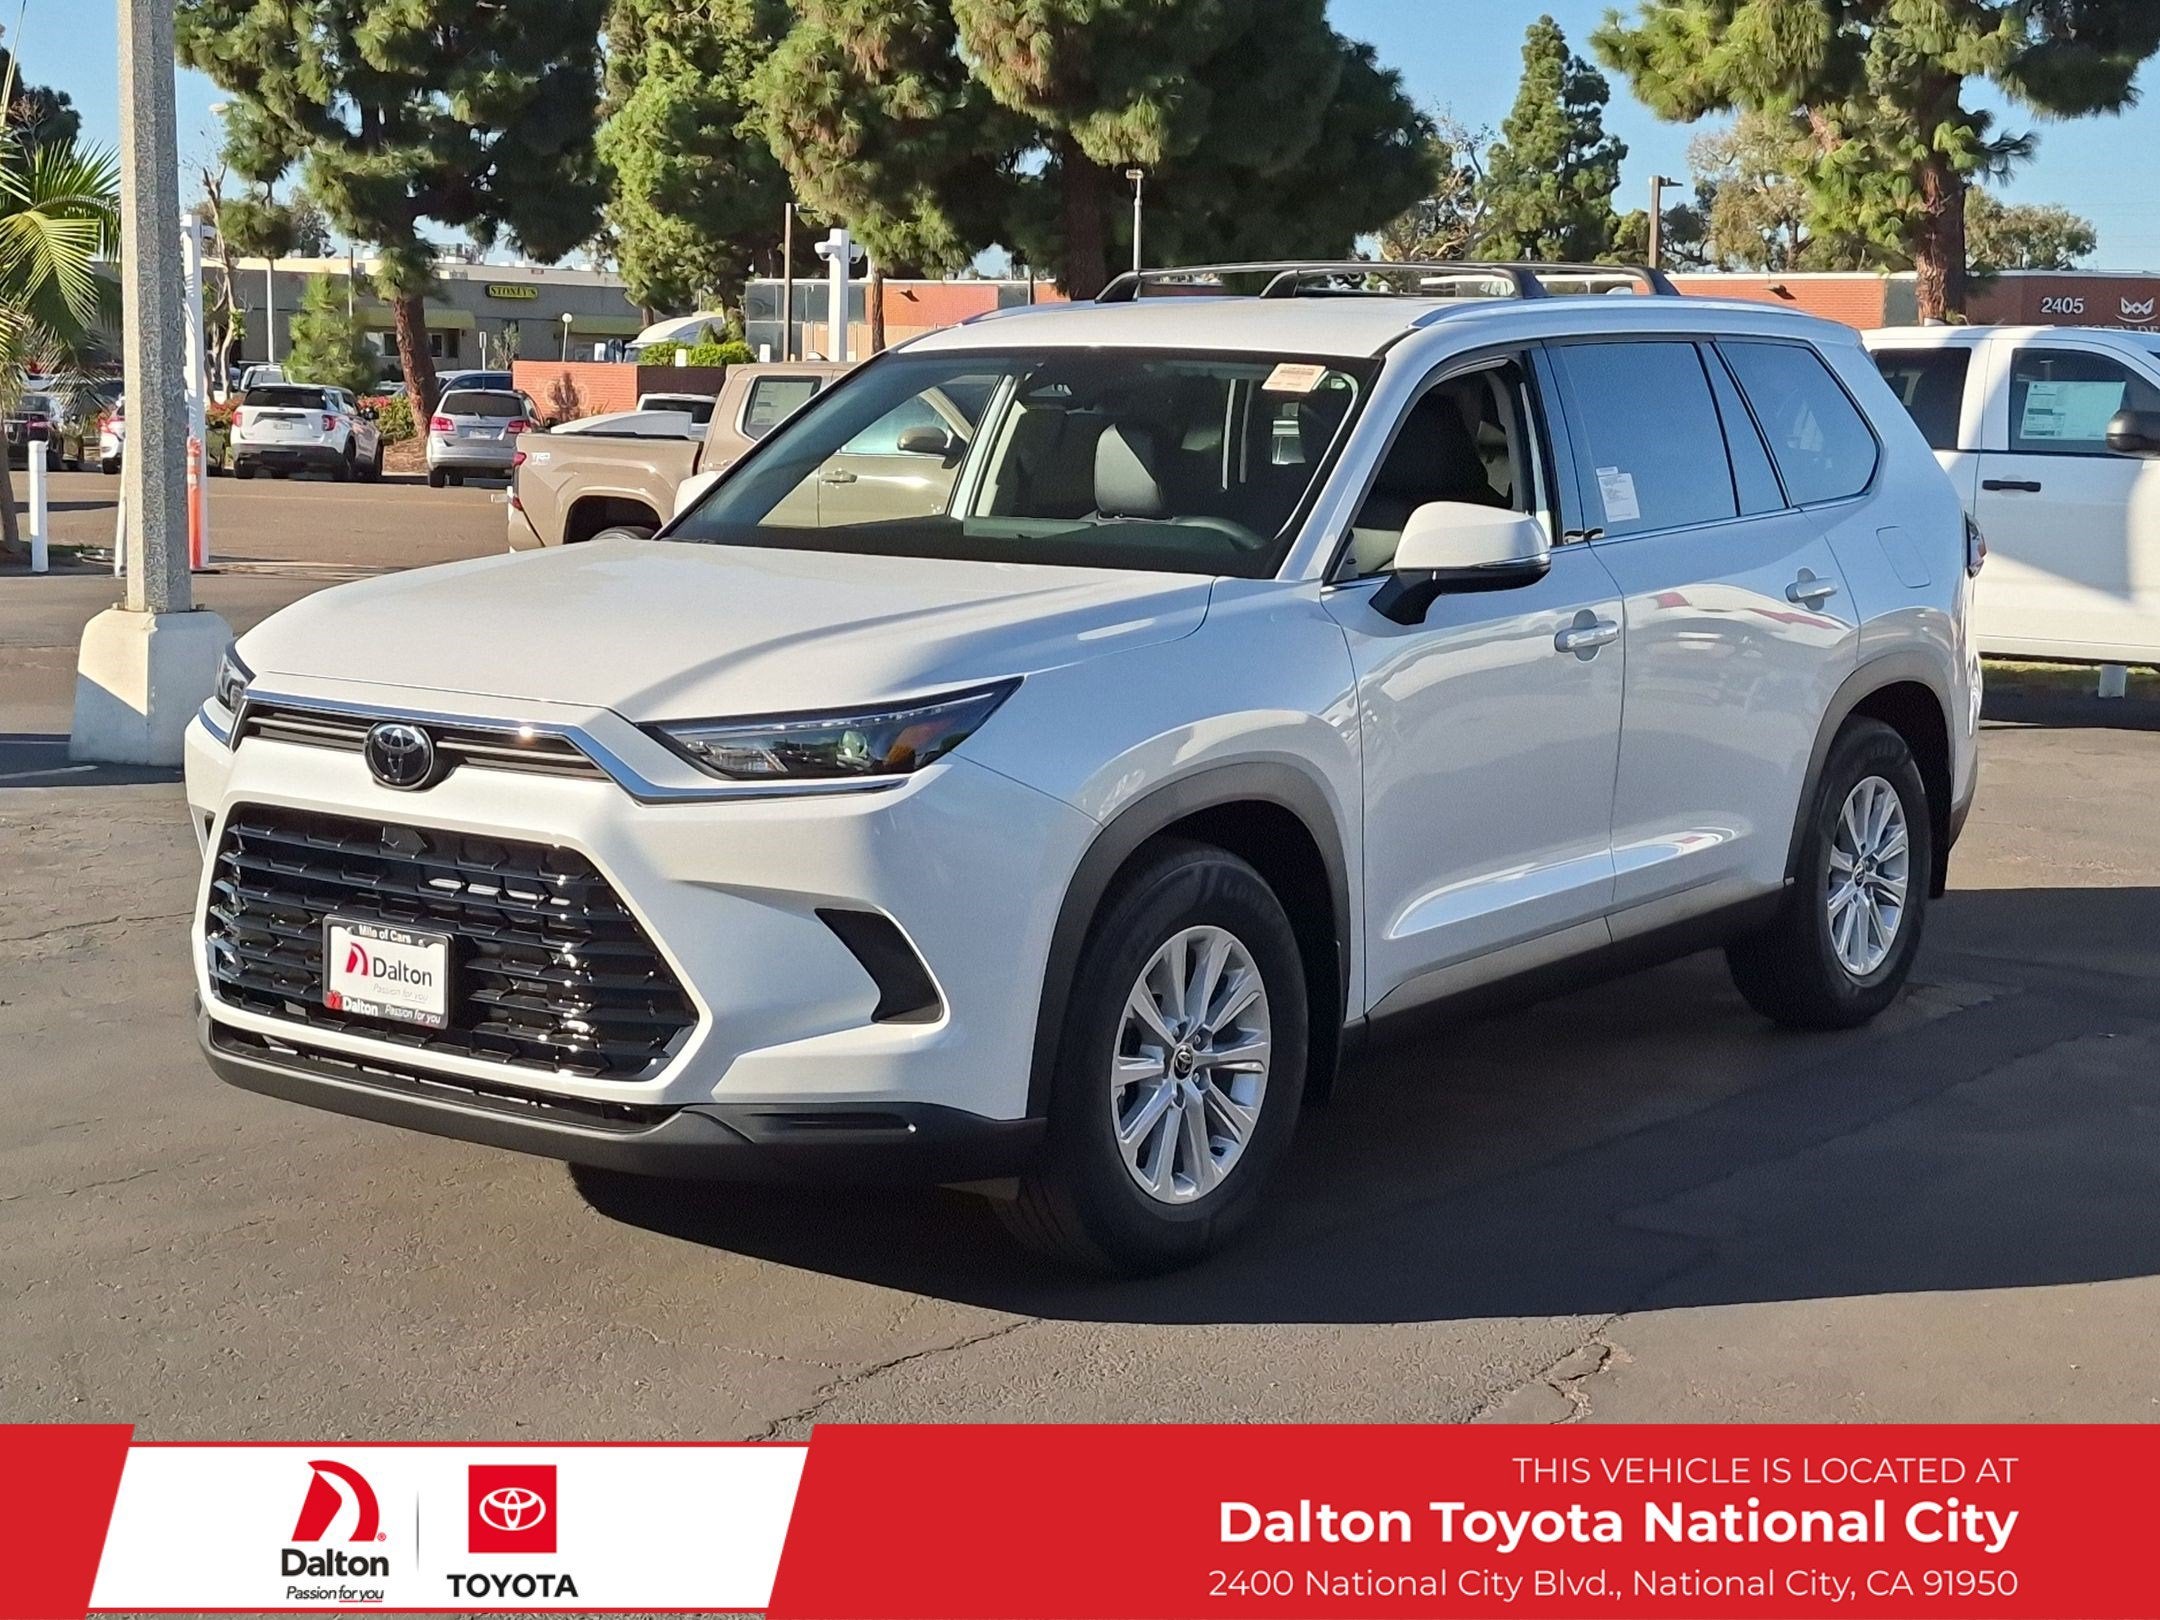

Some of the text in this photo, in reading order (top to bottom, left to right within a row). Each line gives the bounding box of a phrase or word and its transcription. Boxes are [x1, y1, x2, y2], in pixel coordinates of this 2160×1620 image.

[2041, 297, 2084, 314] 2405
[359, 925, 411, 943] Mile of Cars
[373, 956, 432, 987] Dalton
[343, 996, 379, 1017] Dalton
[385, 1004, 441, 1025] Passion for you
